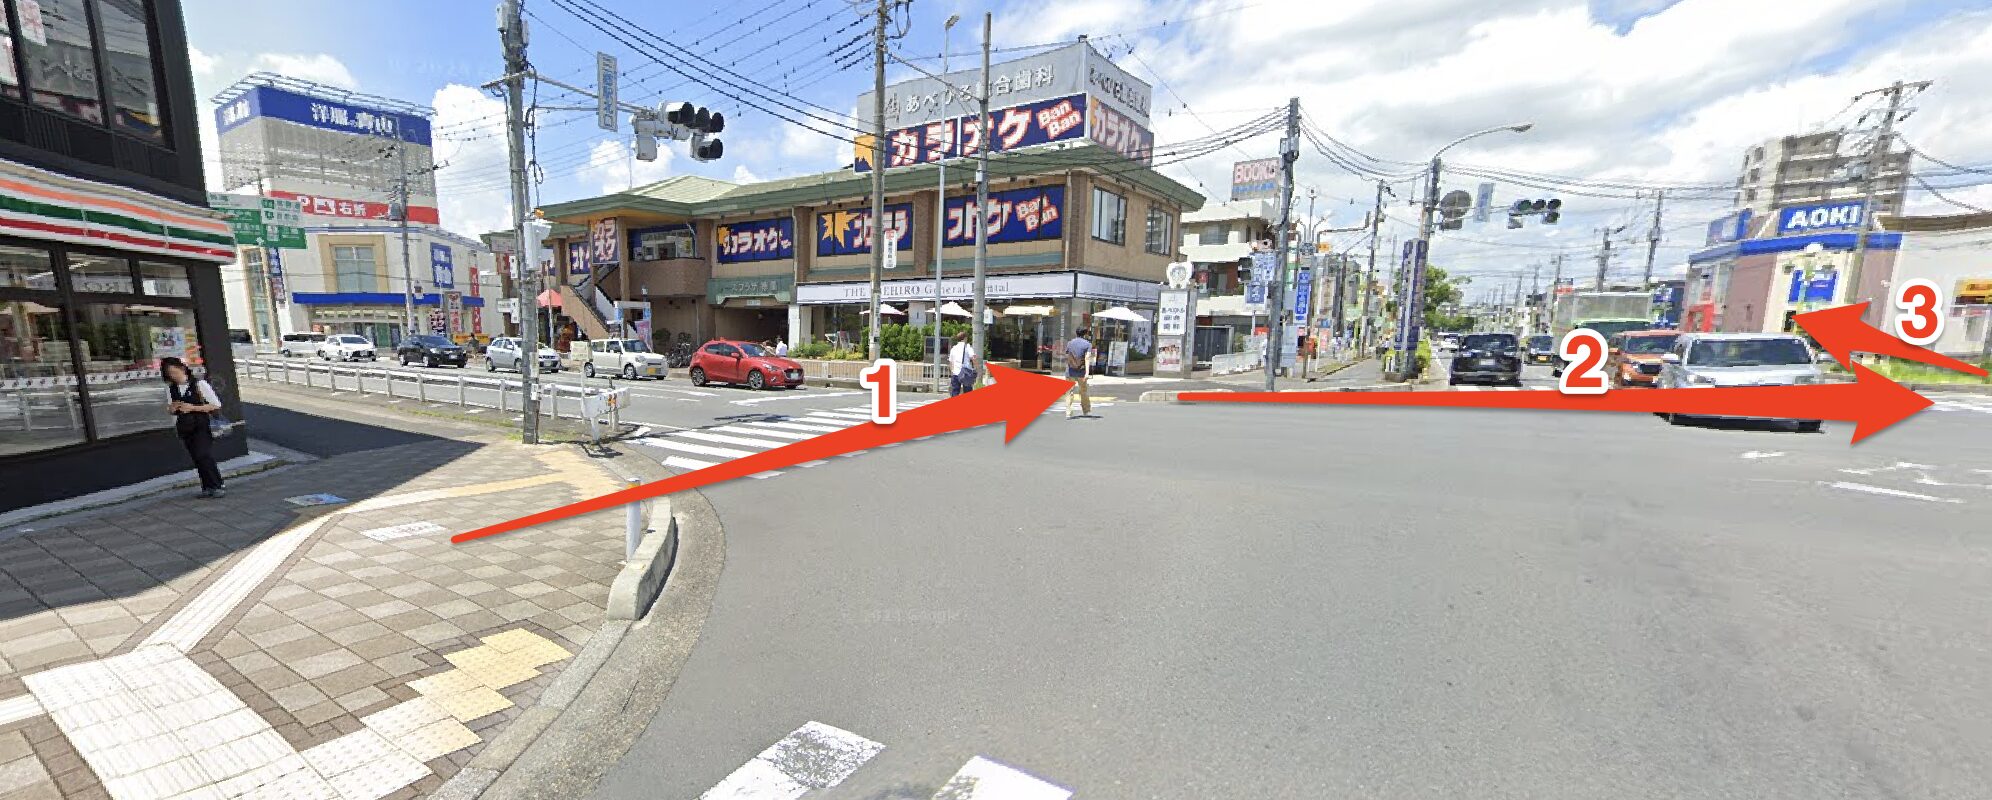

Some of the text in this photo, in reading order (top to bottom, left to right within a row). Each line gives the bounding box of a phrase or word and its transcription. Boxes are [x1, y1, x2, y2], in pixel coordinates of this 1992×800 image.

[891, 100, 1072, 167] カラオケ Ban
[1048, 110, 1082, 138] Ban
[1786, 204, 1862, 230] AOKI
[723, 227, 783, 255] カラオケ
[843, 287, 866, 298] THE
[878, 285, 921, 296] EHIRO
[971, 281, 1010, 294] ntal
